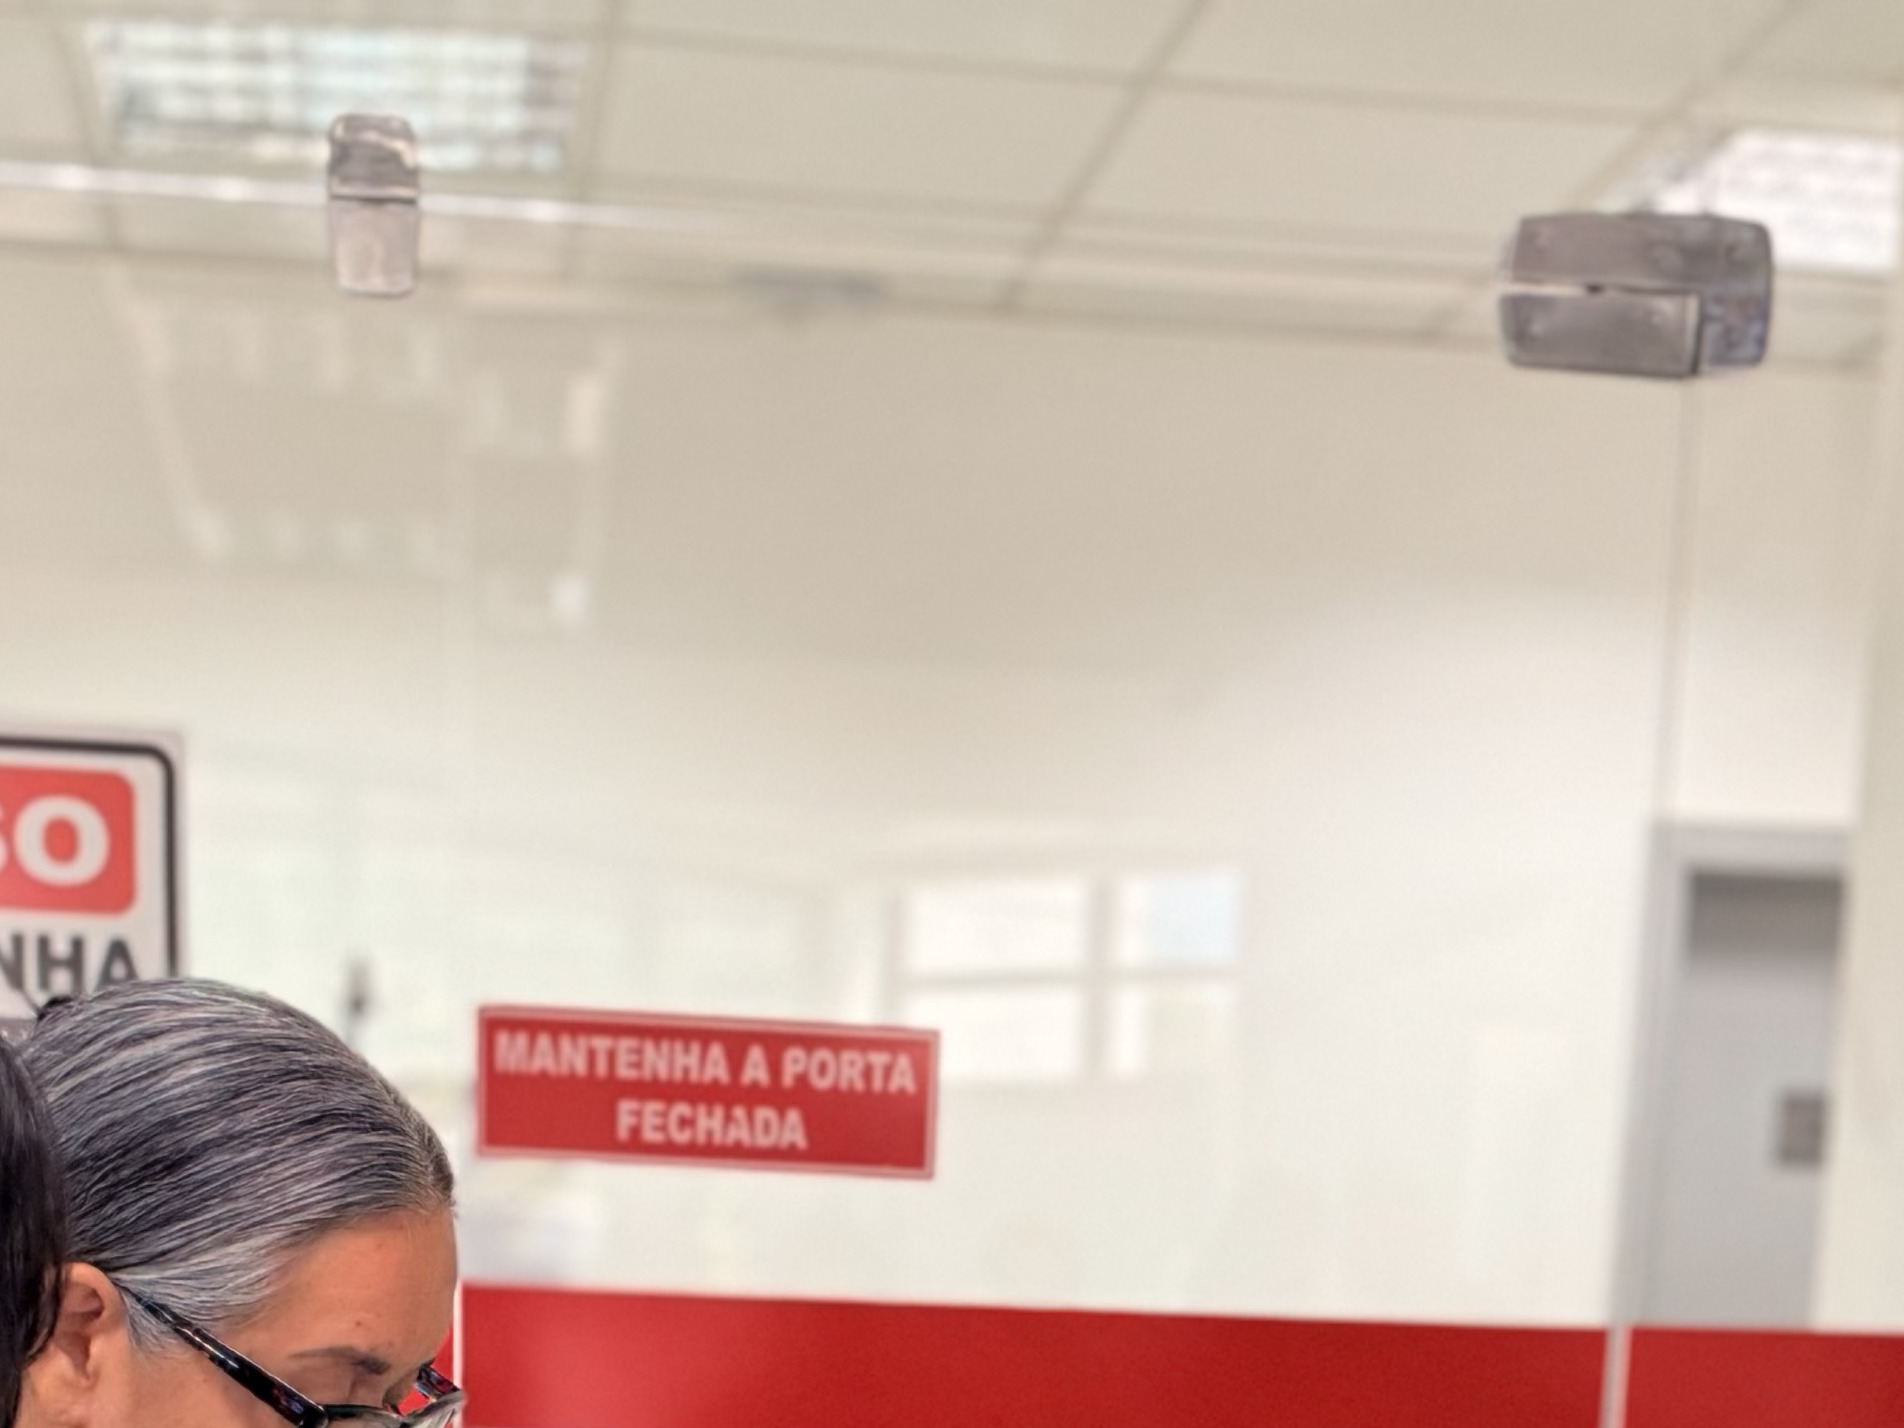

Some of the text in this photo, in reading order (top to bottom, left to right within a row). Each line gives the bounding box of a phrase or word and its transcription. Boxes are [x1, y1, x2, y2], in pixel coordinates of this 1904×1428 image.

[496, 1029, 916, 1095] MANTENHA A PORTA
[616, 1098, 808, 1150] FECHADA
